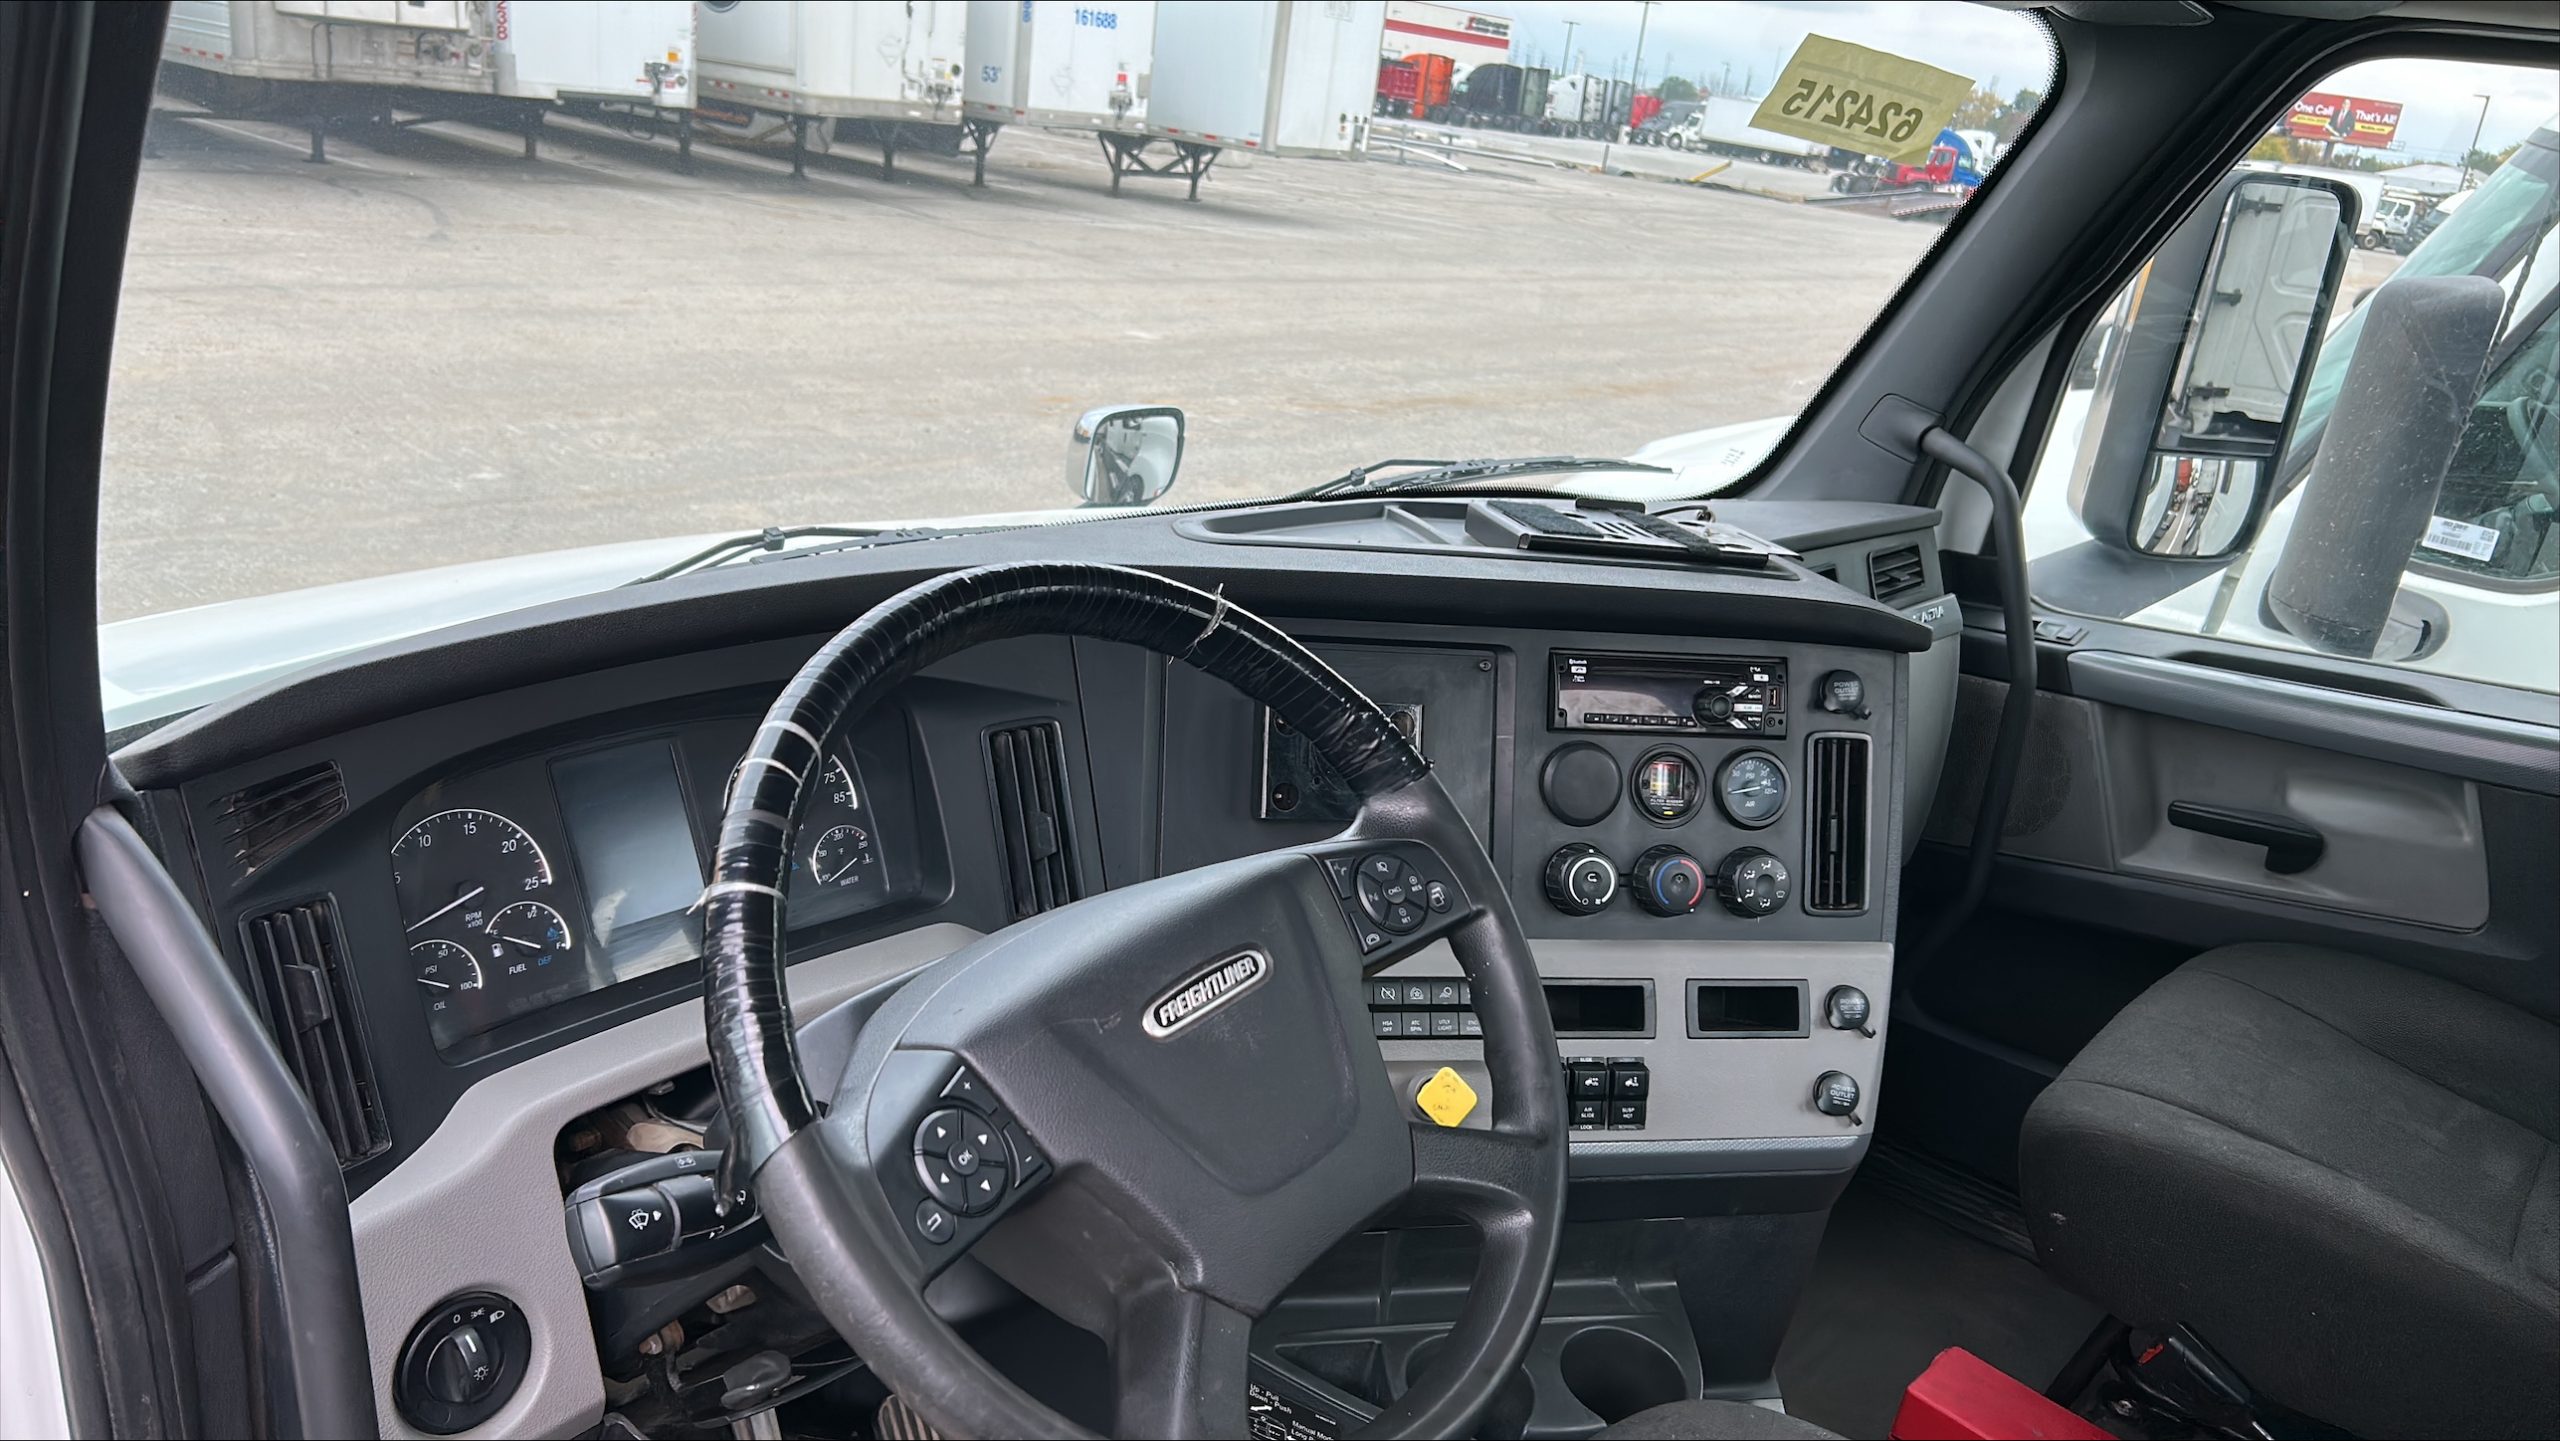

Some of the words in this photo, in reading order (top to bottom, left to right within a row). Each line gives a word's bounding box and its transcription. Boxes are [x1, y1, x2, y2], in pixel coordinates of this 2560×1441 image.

[1074, 8, 1118, 29] 161688
[2294, 101, 2313, 113] One
[2315, 104, 2334, 116] Call
[2355, 109, 2381, 122] That's
[824, 772, 836, 784] 75
[833, 792, 846, 804] 85
[463, 822, 477, 834] 15
[418, 835, 432, 848] 10
[502, 840, 517, 853] 20
[525, 876, 539, 890] 25
[840, 875, 859, 886] WATER
[465, 911, 482, 922] RPM
[467, 919, 483, 929] x100
[438, 949, 449, 958] 50
[425, 965, 438, 975] PSI
[509, 963, 527, 975] FUEL
[460, 981, 473, 990] 100
[1159, 957, 1256, 1026] FREIGHTLINER
[433, 1001, 447, 1011] OIL
[1830, 1089, 1855, 1099] OUTLET
[958, 1148, 973, 1166] OK
[1250, 1389, 1269, 1403] Down
[1274, 1401, 1292, 1414] Push
[1265, 1390, 1280, 1401] Pull
[1292, 1420, 1316, 1436] Manual
